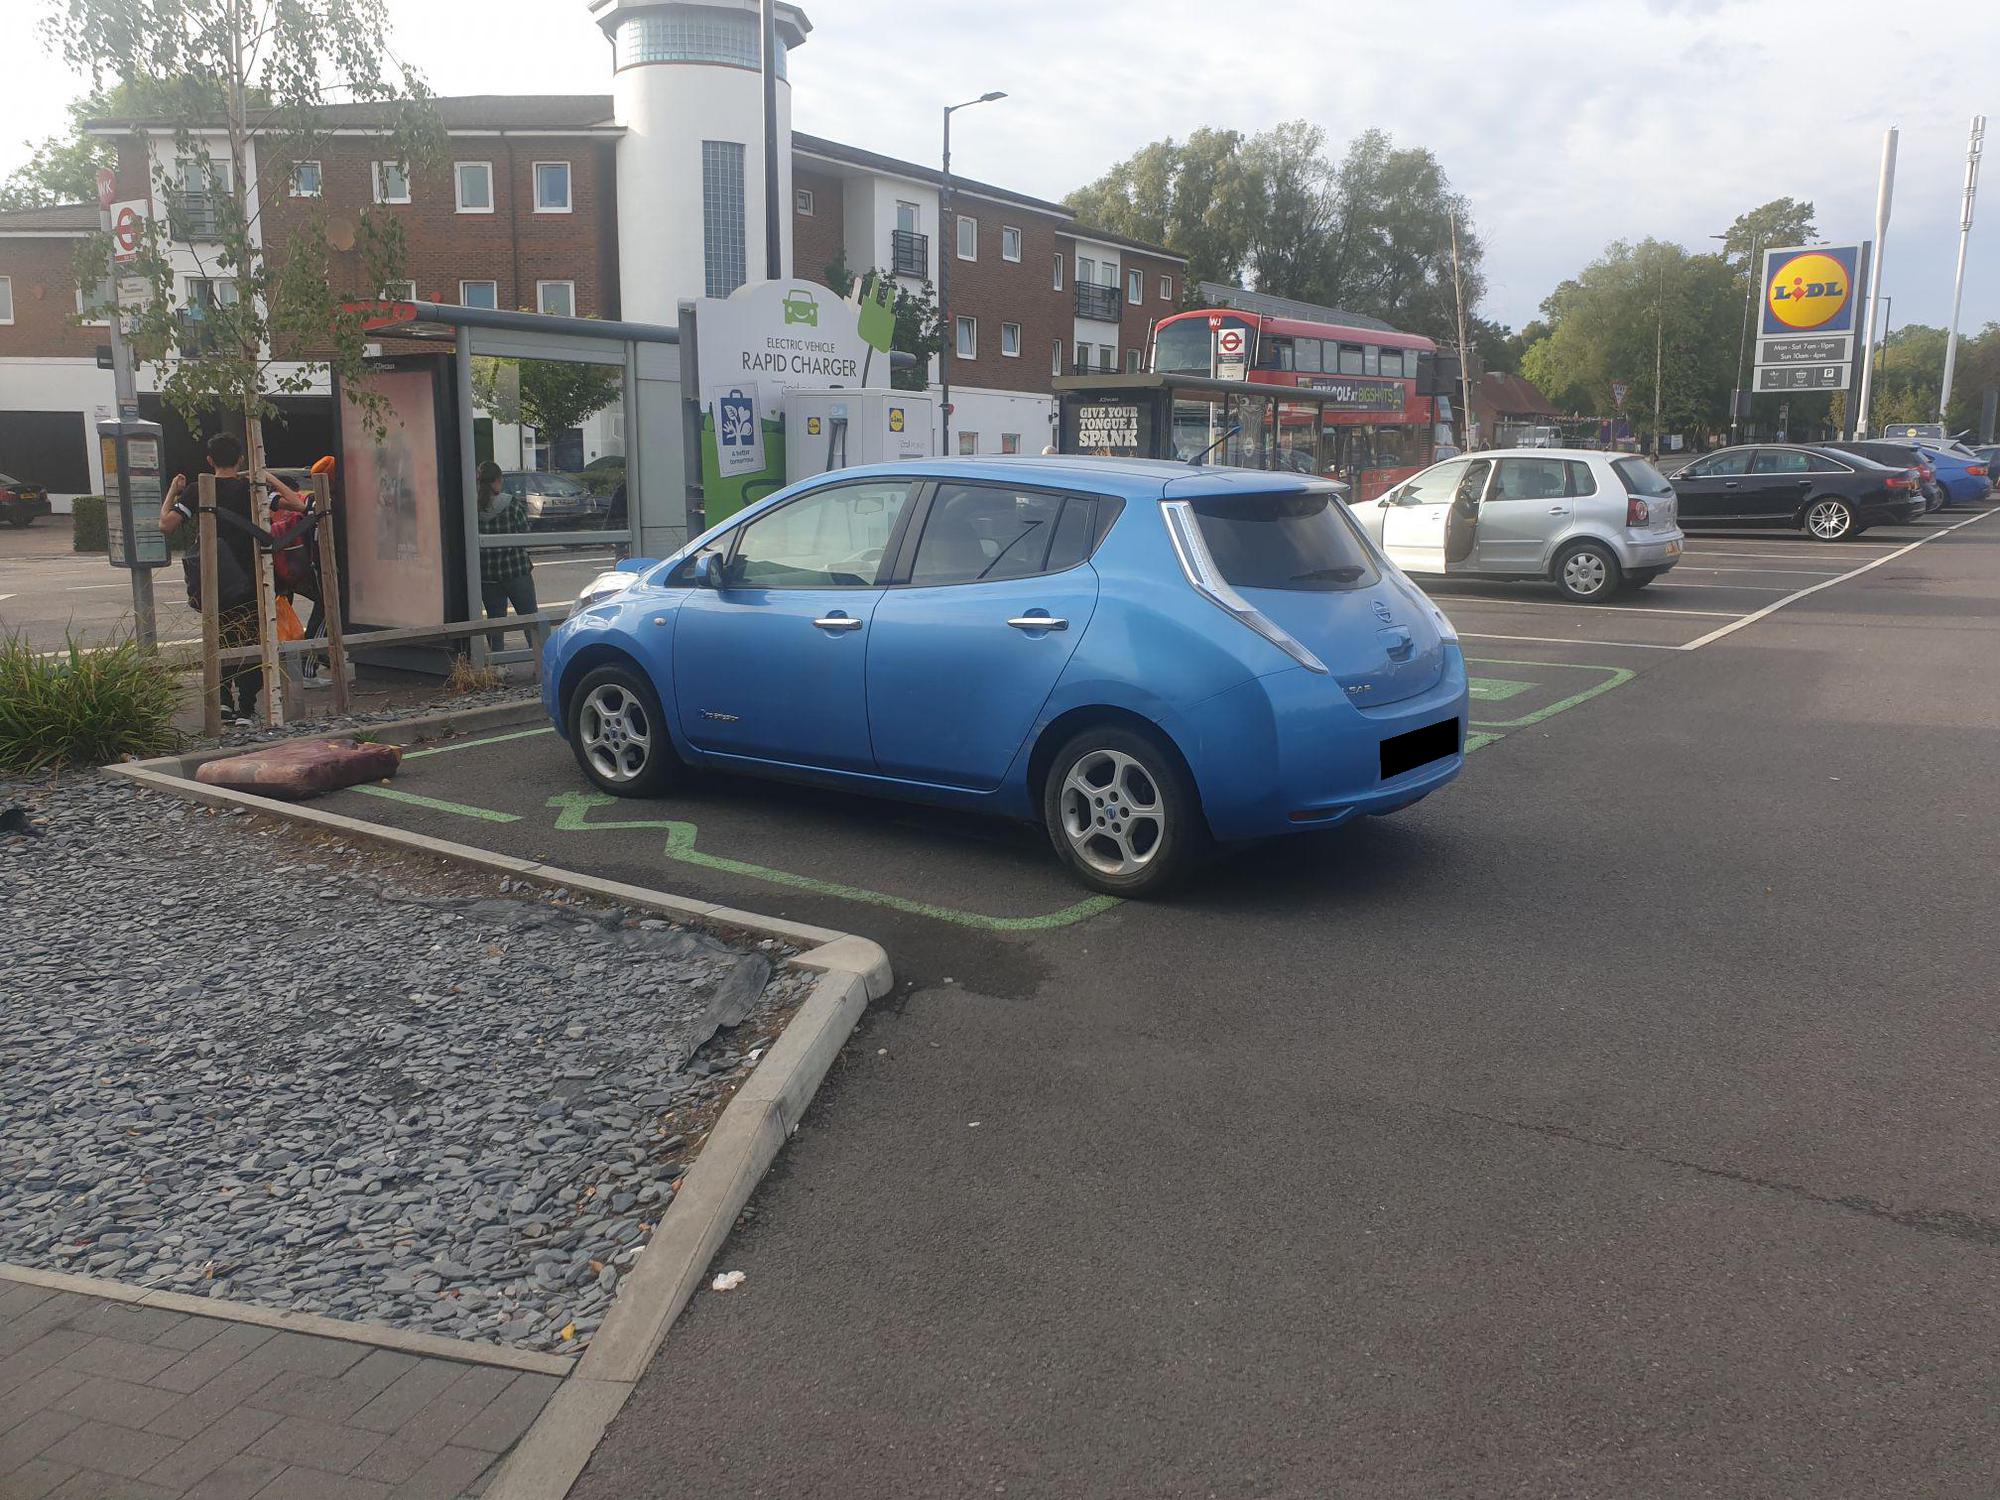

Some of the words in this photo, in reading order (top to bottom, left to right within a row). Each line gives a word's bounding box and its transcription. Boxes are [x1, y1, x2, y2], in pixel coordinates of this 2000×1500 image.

[98, 179, 113, 196] WK
[1210, 317, 1221, 326] WJ
[767, 337, 803, 351] ELECTRIC
[804, 341, 835, 353] VEHICLE
[742, 351, 787, 372] RAPID
[791, 355, 857, 377] CHARGER
[1080, 407, 1106, 418] GIVE
[1108, 406, 1138, 418] YOUR
[1080, 418, 1128, 430] TONGUE
[1130, 418, 1138, 429] A
[1079, 430, 1138, 447] SPANK
